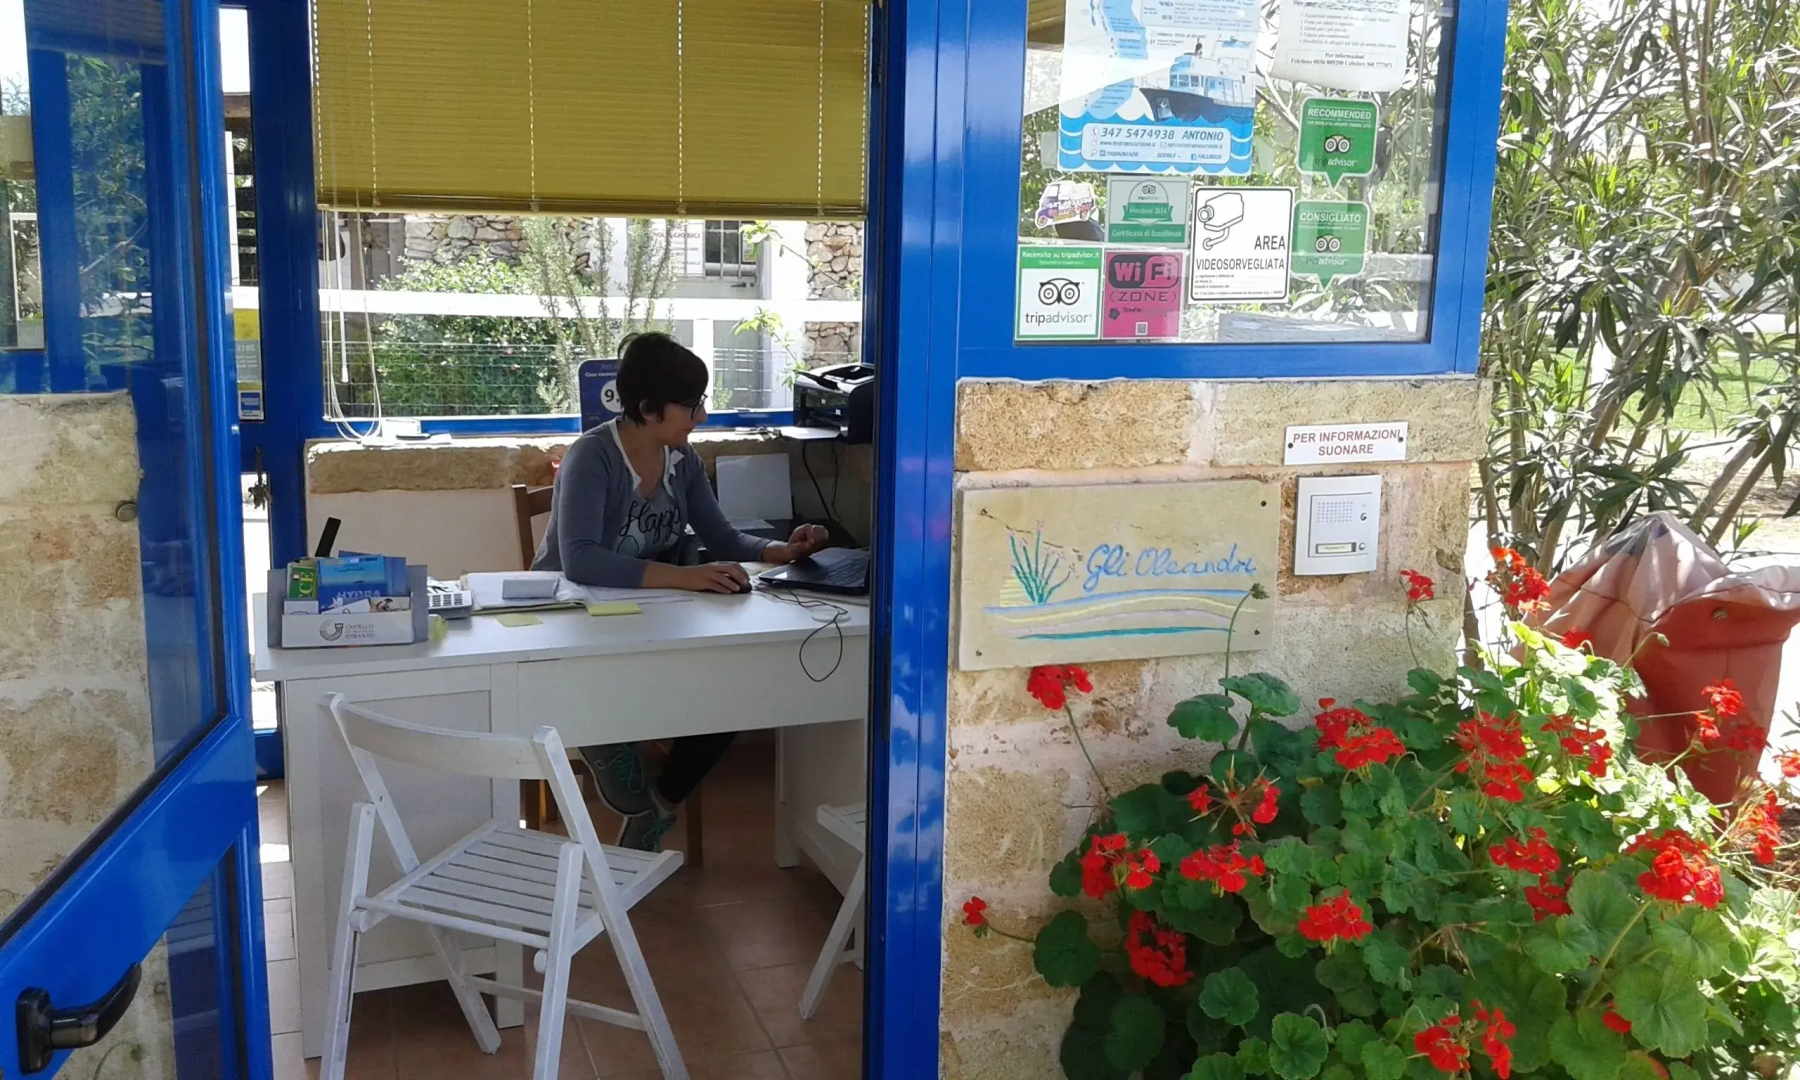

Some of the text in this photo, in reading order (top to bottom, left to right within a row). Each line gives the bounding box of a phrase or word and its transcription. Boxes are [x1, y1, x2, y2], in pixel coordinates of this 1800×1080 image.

[1308, 108, 1371, 119] RECOMMENDED
[1101, 127, 1224, 141] 347 5474938 ANTONIO
[1300, 212, 1361, 223] CONSIGLIATO
[1112, 229, 1143, 237] Certificato
[1144, 229, 1150, 237] di
[1254, 235, 1286, 250] AREA
[1022, 250, 1052, 258] Recensito
[1061, 251, 1100, 259] tripadvisor.it
[1196, 258, 1285, 270] VIDEOSORVEGLIATA
[1119, 291, 1168, 301] ZONE
[1025, 311, 1088, 326] tripadvisor
[604, 388, 620, 403] 9.
[1293, 429, 1401, 443] PER INFORMAZIONI
[1318, 444, 1374, 456] SUONARE
[619, 501, 680, 544] Happ
[1083, 543, 1257, 592] Gli Oleandri
[299, 572, 314, 598] CE
